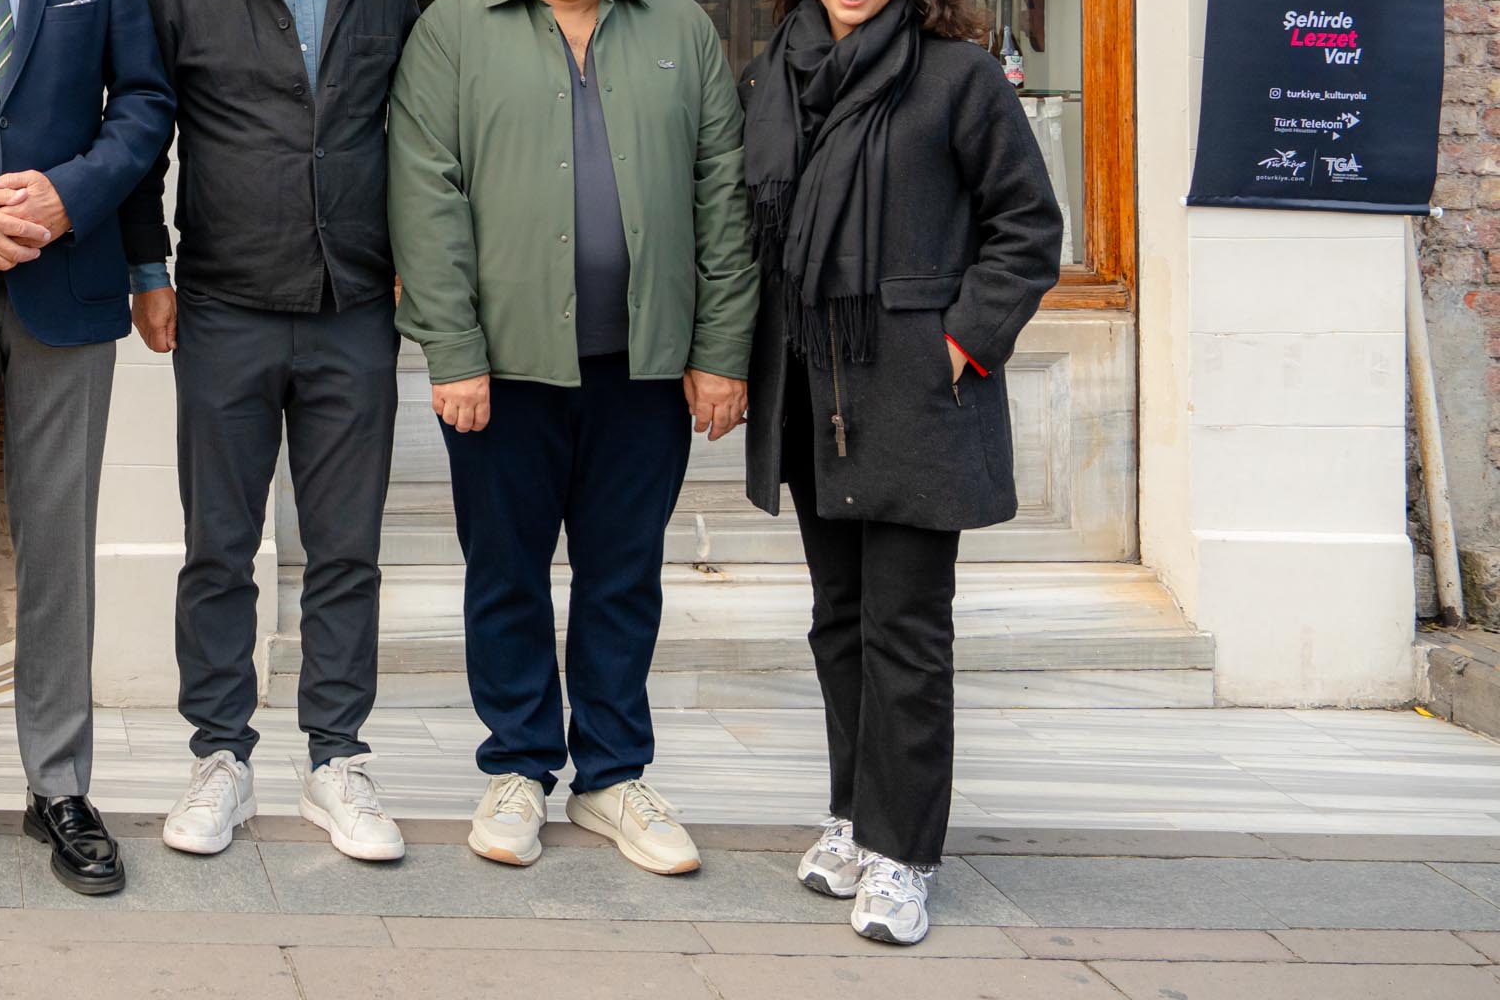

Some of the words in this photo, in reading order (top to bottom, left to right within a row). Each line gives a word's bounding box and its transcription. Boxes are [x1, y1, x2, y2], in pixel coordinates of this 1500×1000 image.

[1283, 11, 1353, 31] Şehirde
[1290, 28, 1358, 48] Lezzet
[1324, 48, 1362, 65] Var!
[1286, 90, 1367, 101] turkiye_kulturyolu
[1274, 117, 1298, 128] Türk
[1300, 118, 1343, 129] Telekom
[1320, 153, 1362, 176] TGA
